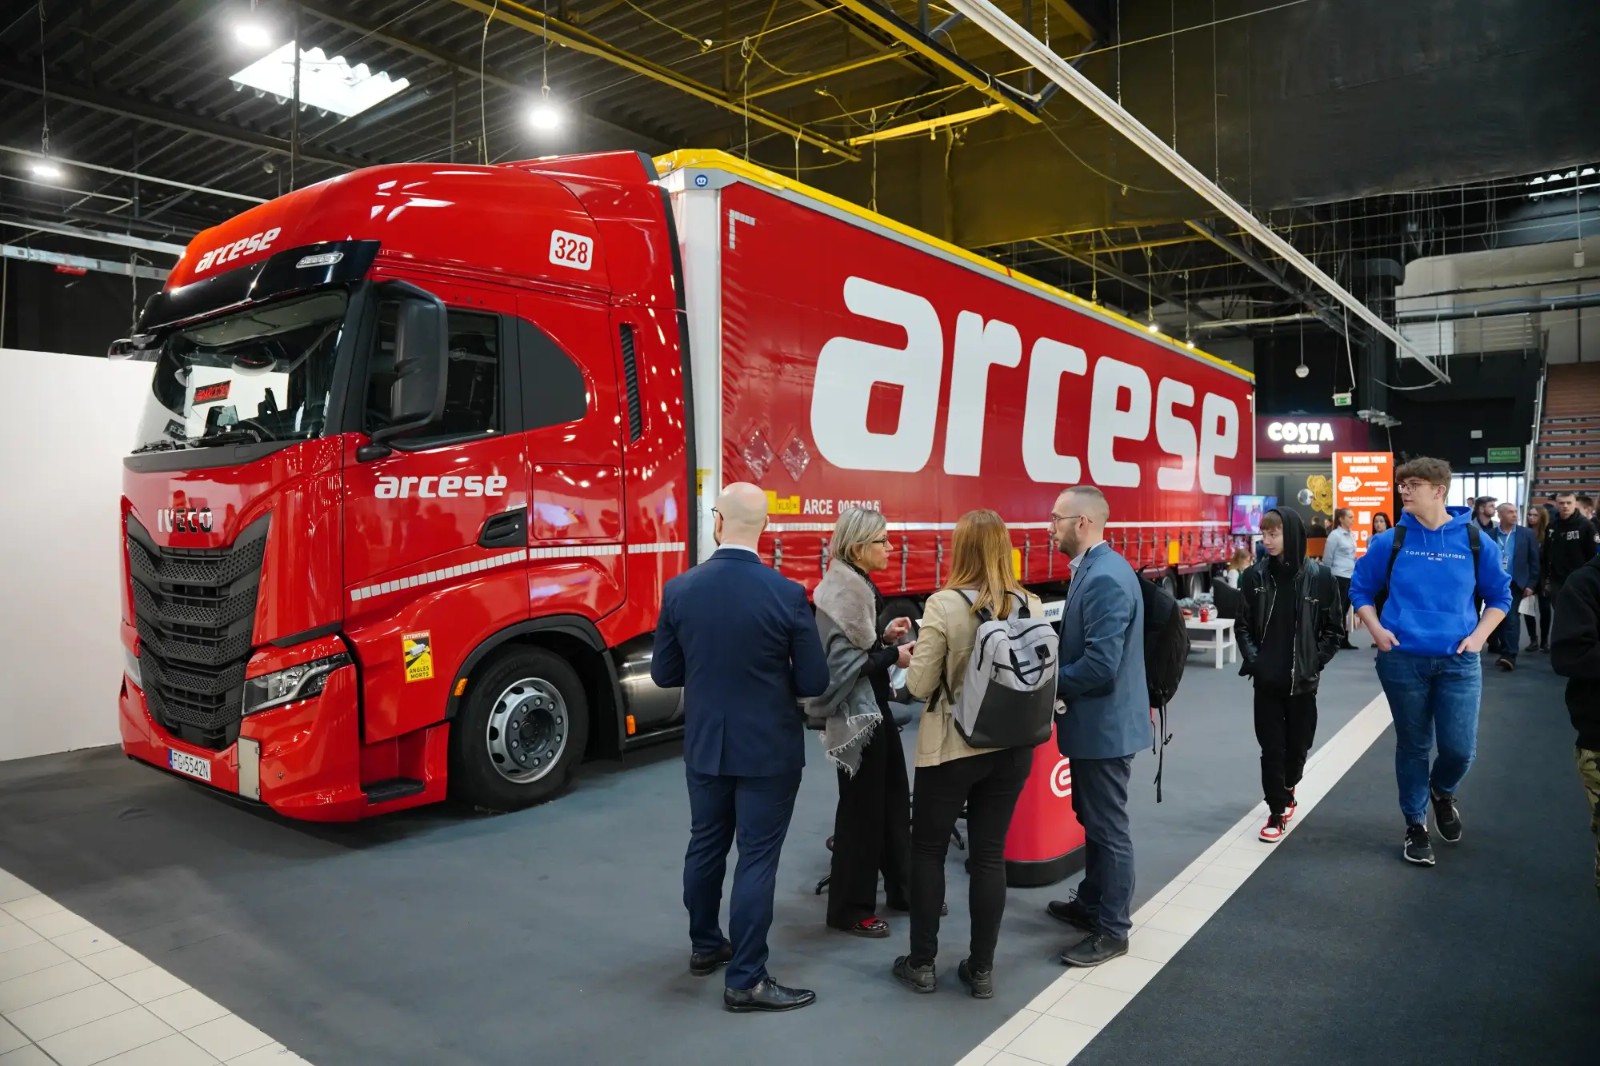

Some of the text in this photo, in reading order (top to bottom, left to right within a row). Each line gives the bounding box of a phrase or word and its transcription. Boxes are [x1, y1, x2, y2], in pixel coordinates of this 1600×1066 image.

[195, 227, 281, 273] arcese
[554, 236, 588, 264] 328
[810, 276, 1239, 496] arcese
[1267, 422, 1334, 443] COSTA
[374, 476, 507, 499] arcese
[803, 499, 833, 515] ARCE
[157, 508, 213, 533] IVECO
[409, 665, 430, 673] ANGLES
